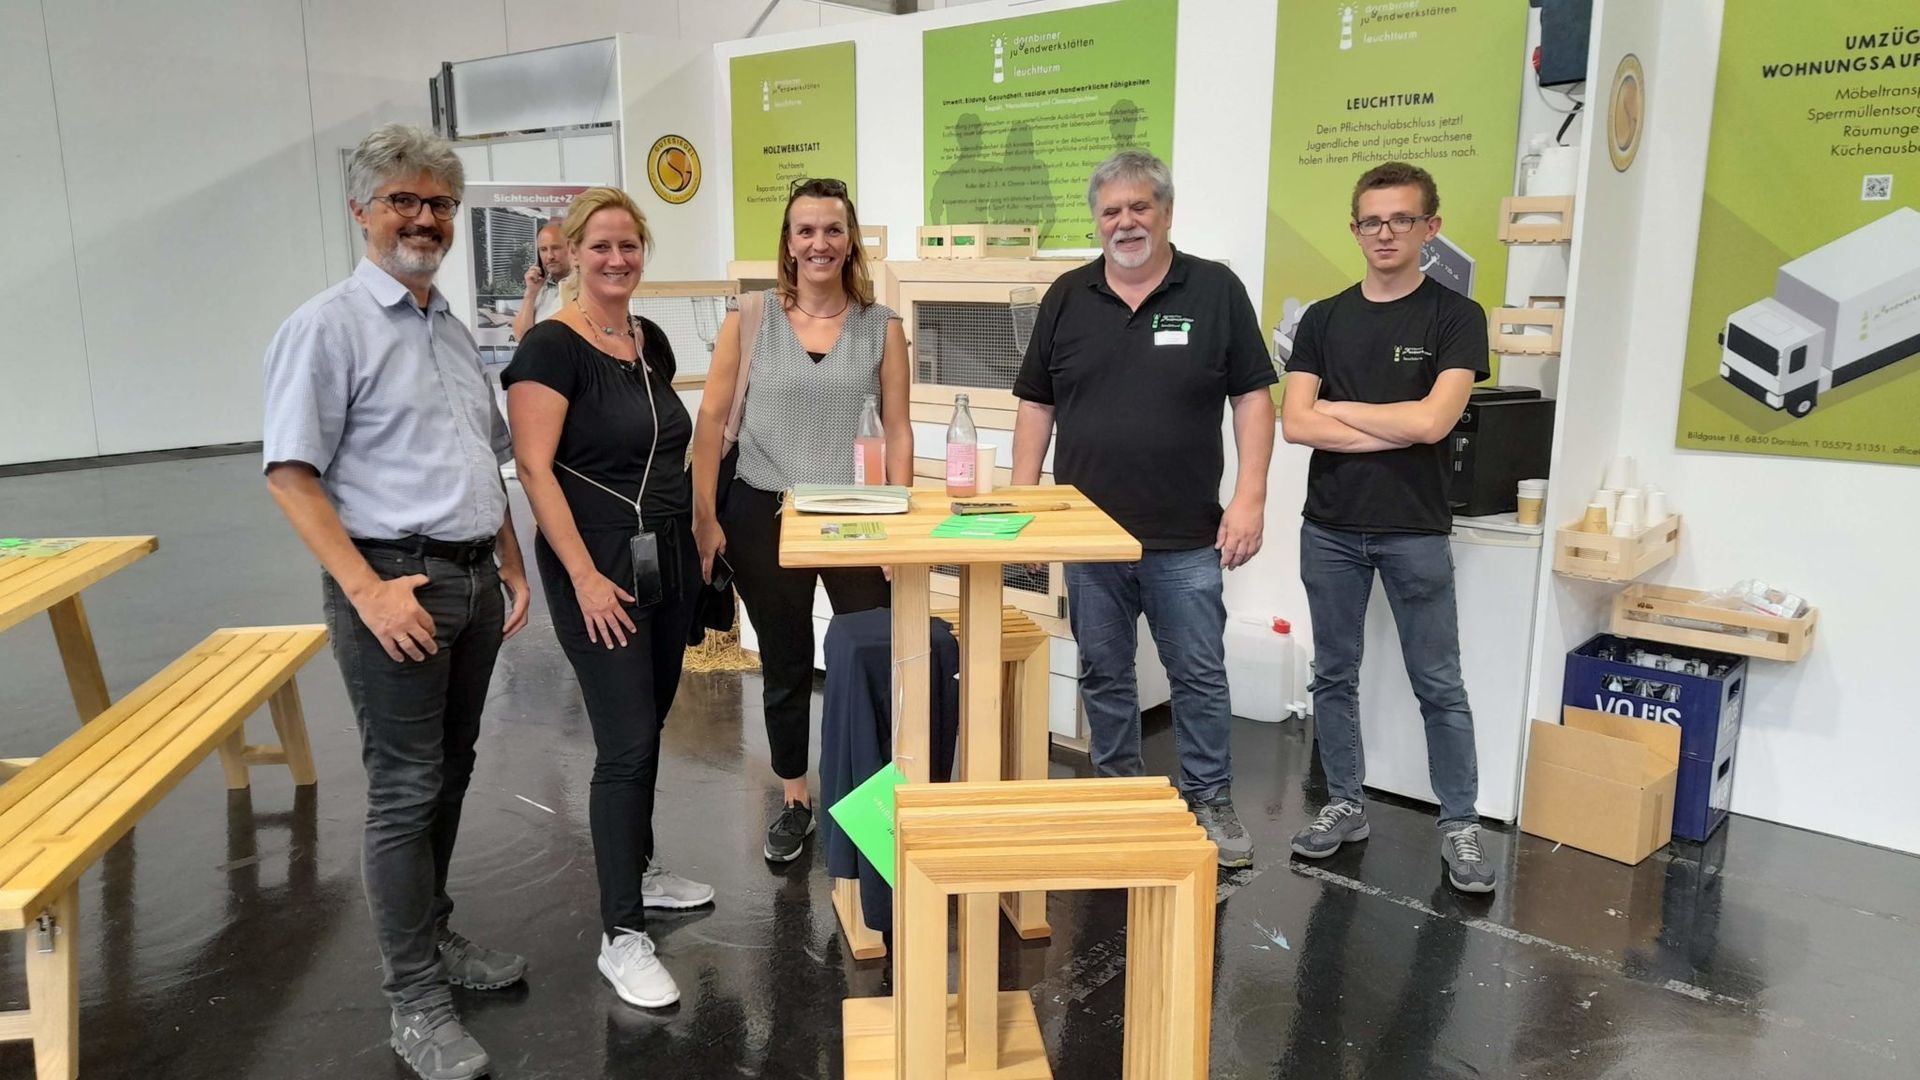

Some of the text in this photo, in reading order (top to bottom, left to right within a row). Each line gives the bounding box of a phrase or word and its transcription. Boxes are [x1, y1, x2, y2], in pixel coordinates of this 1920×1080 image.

[1363, 30, 1419, 44] leuchtturm
[1013, 62, 1061, 77] leuchtturm
[1110, 79, 1150, 89] Fähigkeiten
[1347, 92, 1435, 111] LEUCHTTURM
[1316, 123, 1337, 135] Dein
[1340, 117, 1436, 133] Pflichtschulabschluss
[763, 142, 821, 155] HOLZWERKSTATT
[1306, 132, 1472, 153] Jugendliche und junge Erwachsene
[1830, 140, 1920, 157] Küchenausb
[1298, 153, 1323, 165] holen
[1326, 152, 1349, 164] ihren
[1351, 147, 1448, 163] Pflichtschulabschluss
[493, 193, 576, 203] Sichtschutz+Z
[1687, 431, 1727, 442] Bildgasse
[1745, 436, 1769, 445] 6850
[1822, 441, 1852, 451] 05572
